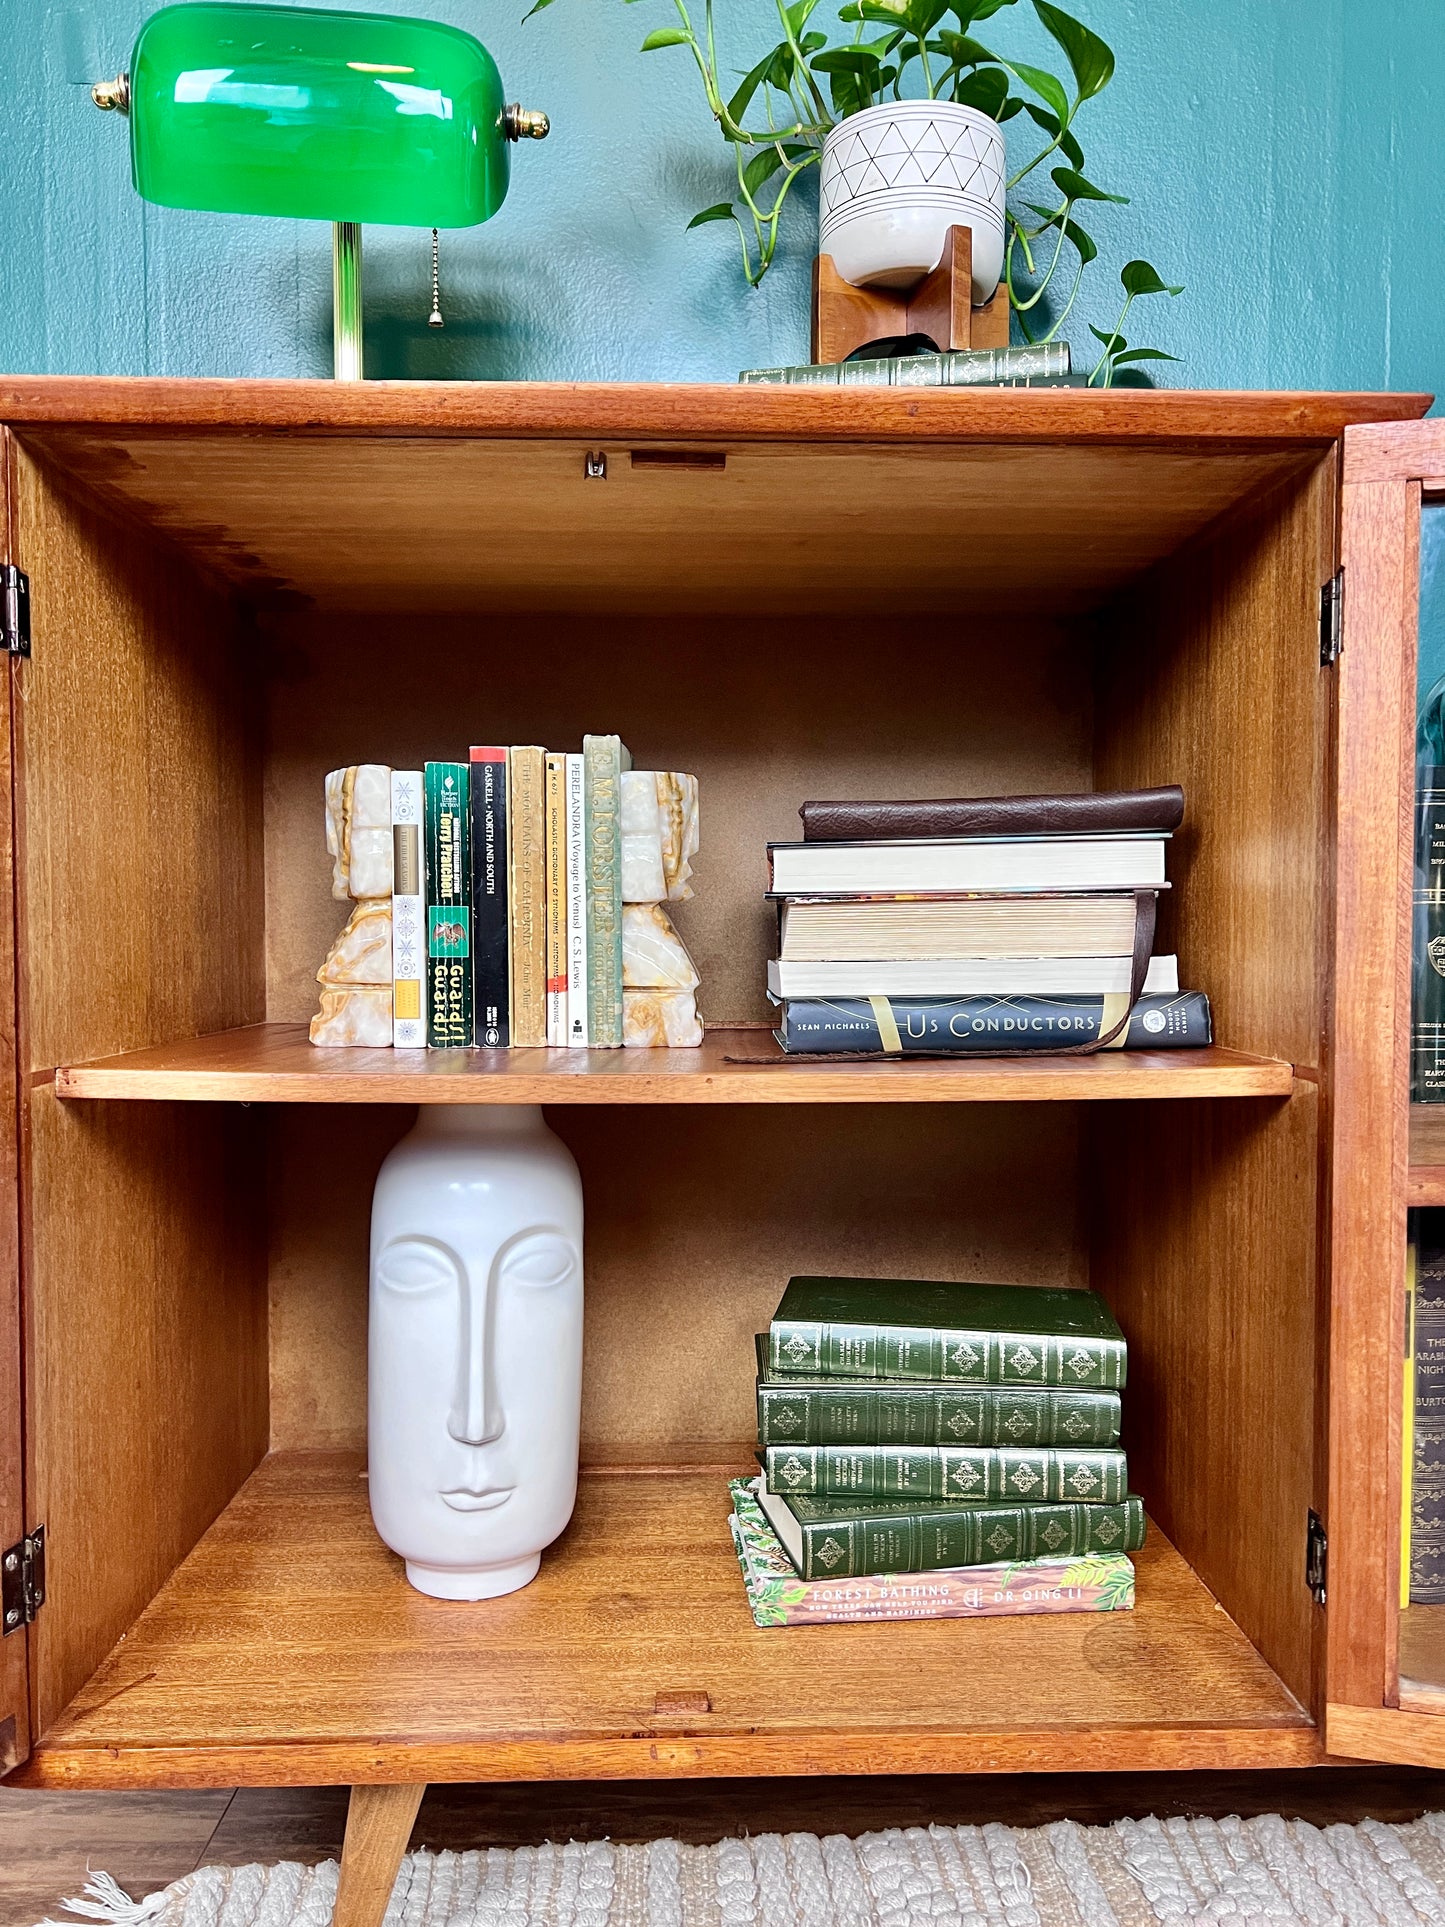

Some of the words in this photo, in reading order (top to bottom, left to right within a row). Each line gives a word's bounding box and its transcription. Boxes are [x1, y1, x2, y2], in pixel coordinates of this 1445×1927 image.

[485, 766, 495, 803] GASKELL
[523, 764, 531, 783] THE
[572, 763, 582, 838] PERELANDRA
[592, 778, 614, 805] M.
[439, 813, 453, 841] Terry
[486, 810, 495, 841] NORTH
[523, 790, 531, 856] MOUNTAINS
[486, 842, 495, 855] AND
[570, 840, 582, 880] (Voyage
[441, 844, 453, 897] Pratchett
[486, 857, 496, 894] SOUTH
[523, 862, 531, 876] OF
[592, 811, 615, 933] FORSTER
[553, 889, 559, 897] OF
[573, 882, 581, 892] to
[523, 881, 532, 946] CALIFORNIA
[571, 895, 582, 929] Venus)
[573, 936, 582, 946] C.
[573, 949, 582, 958] S.
[572, 960, 582, 989] Lewis
[434, 965, 450, 1040] Guards!
[449, 965, 466, 1040] Guards!
[1416, 1352, 1445, 1361] ARABI
[813, 1589, 871, 1601] FOREST
[880, 1585, 950, 1598] BATHING
[994, 1591, 1018, 1602] DR.
[1022, 1589, 1061, 1601] QING
[1068, 1588, 1081, 1598] LI
